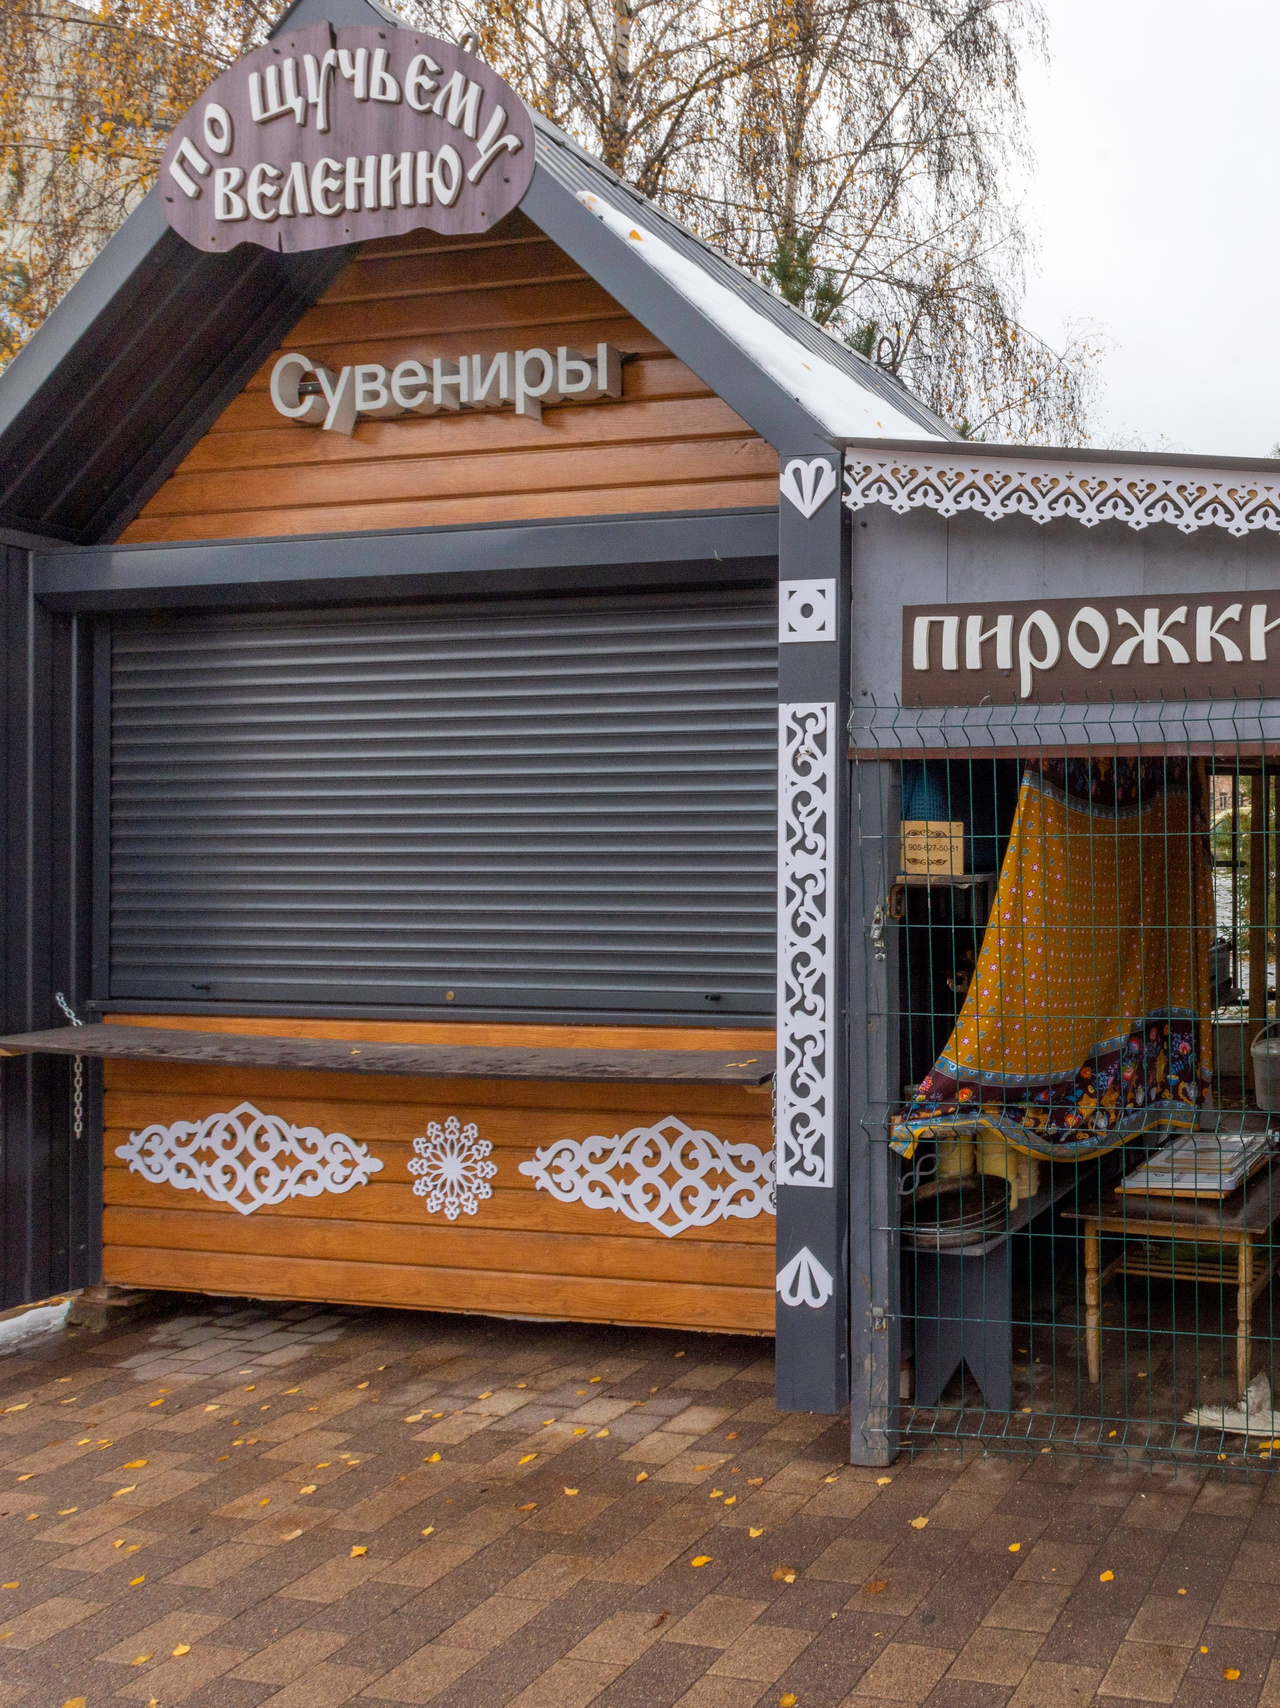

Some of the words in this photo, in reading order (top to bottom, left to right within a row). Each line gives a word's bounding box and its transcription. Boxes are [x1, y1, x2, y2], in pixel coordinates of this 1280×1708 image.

[168, 102, 234, 199] ПО
[248, 46, 523, 184] ЩУЧЬЕМУ
[214, 144, 465, 222] ВЕЛЕНИЮ
[269, 342, 612, 432] Сувениры
